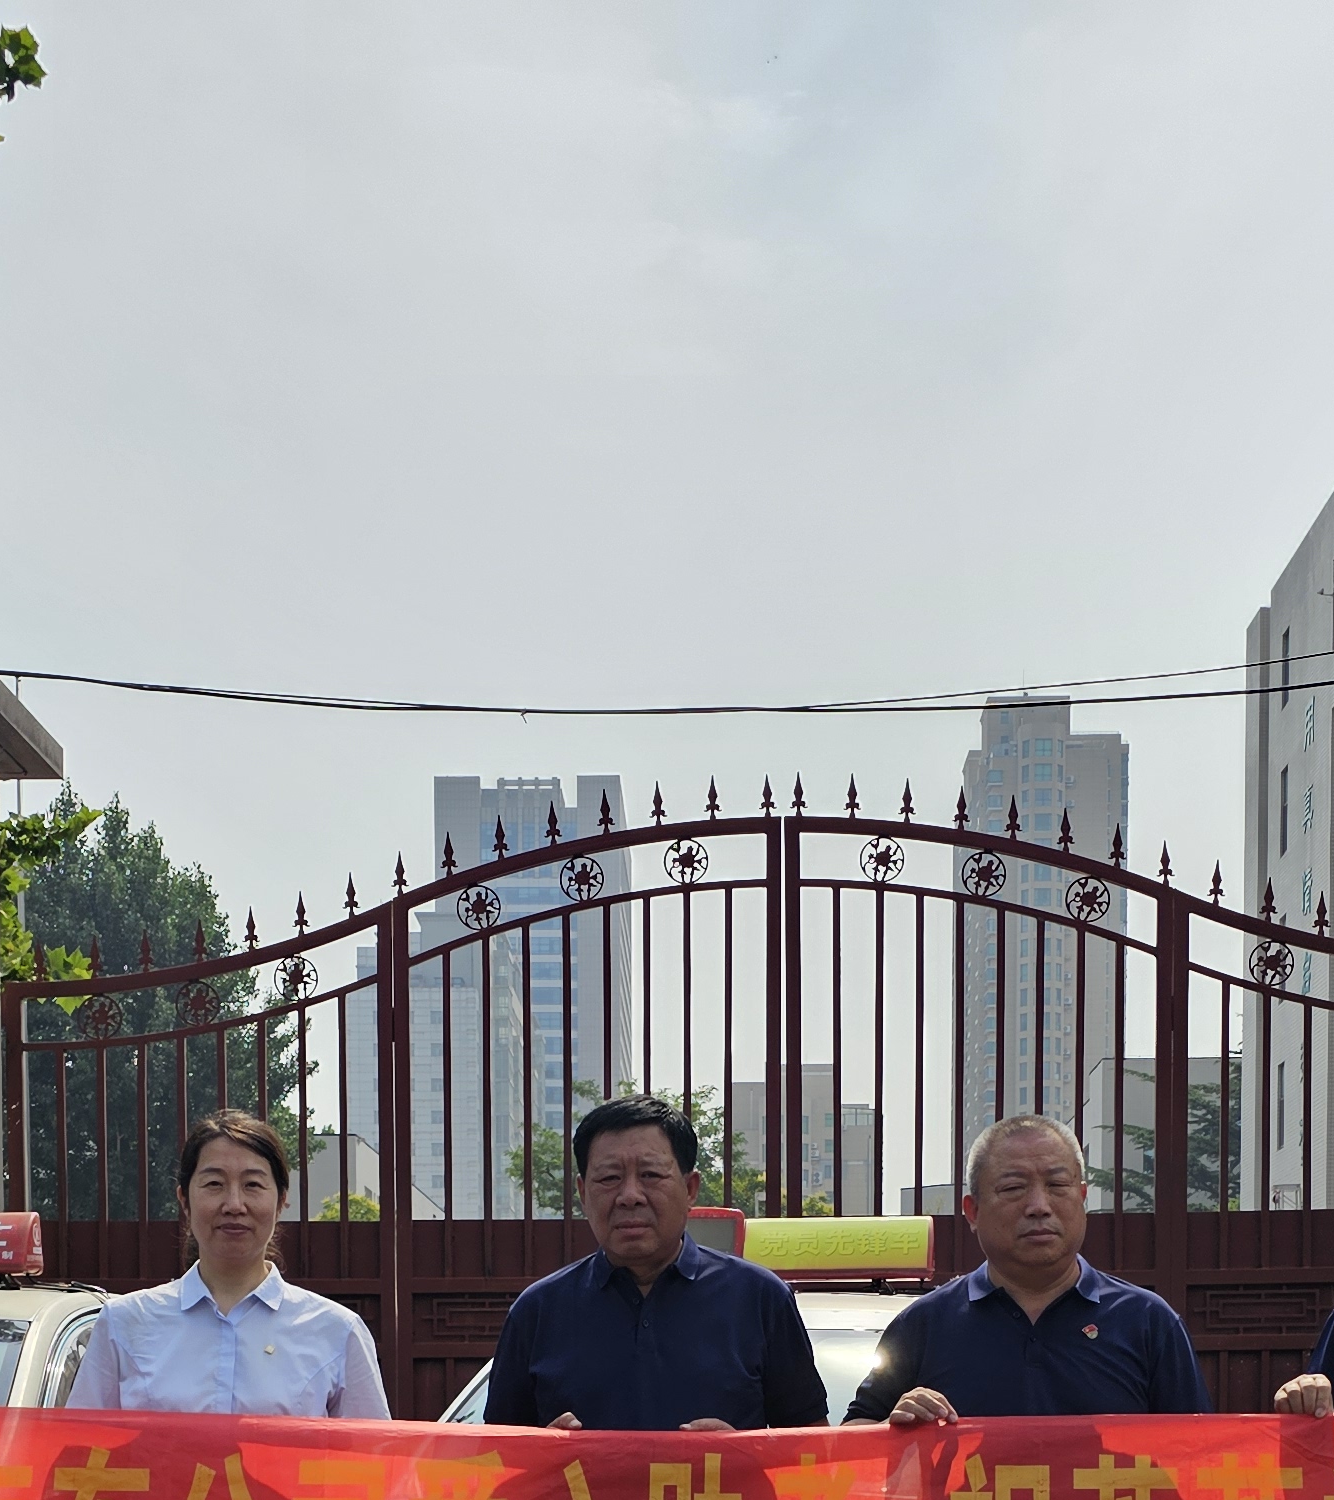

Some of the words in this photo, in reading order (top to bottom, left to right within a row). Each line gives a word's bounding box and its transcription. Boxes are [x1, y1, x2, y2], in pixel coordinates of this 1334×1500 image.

[760, 1230, 920, 1257] 党员先锋车
